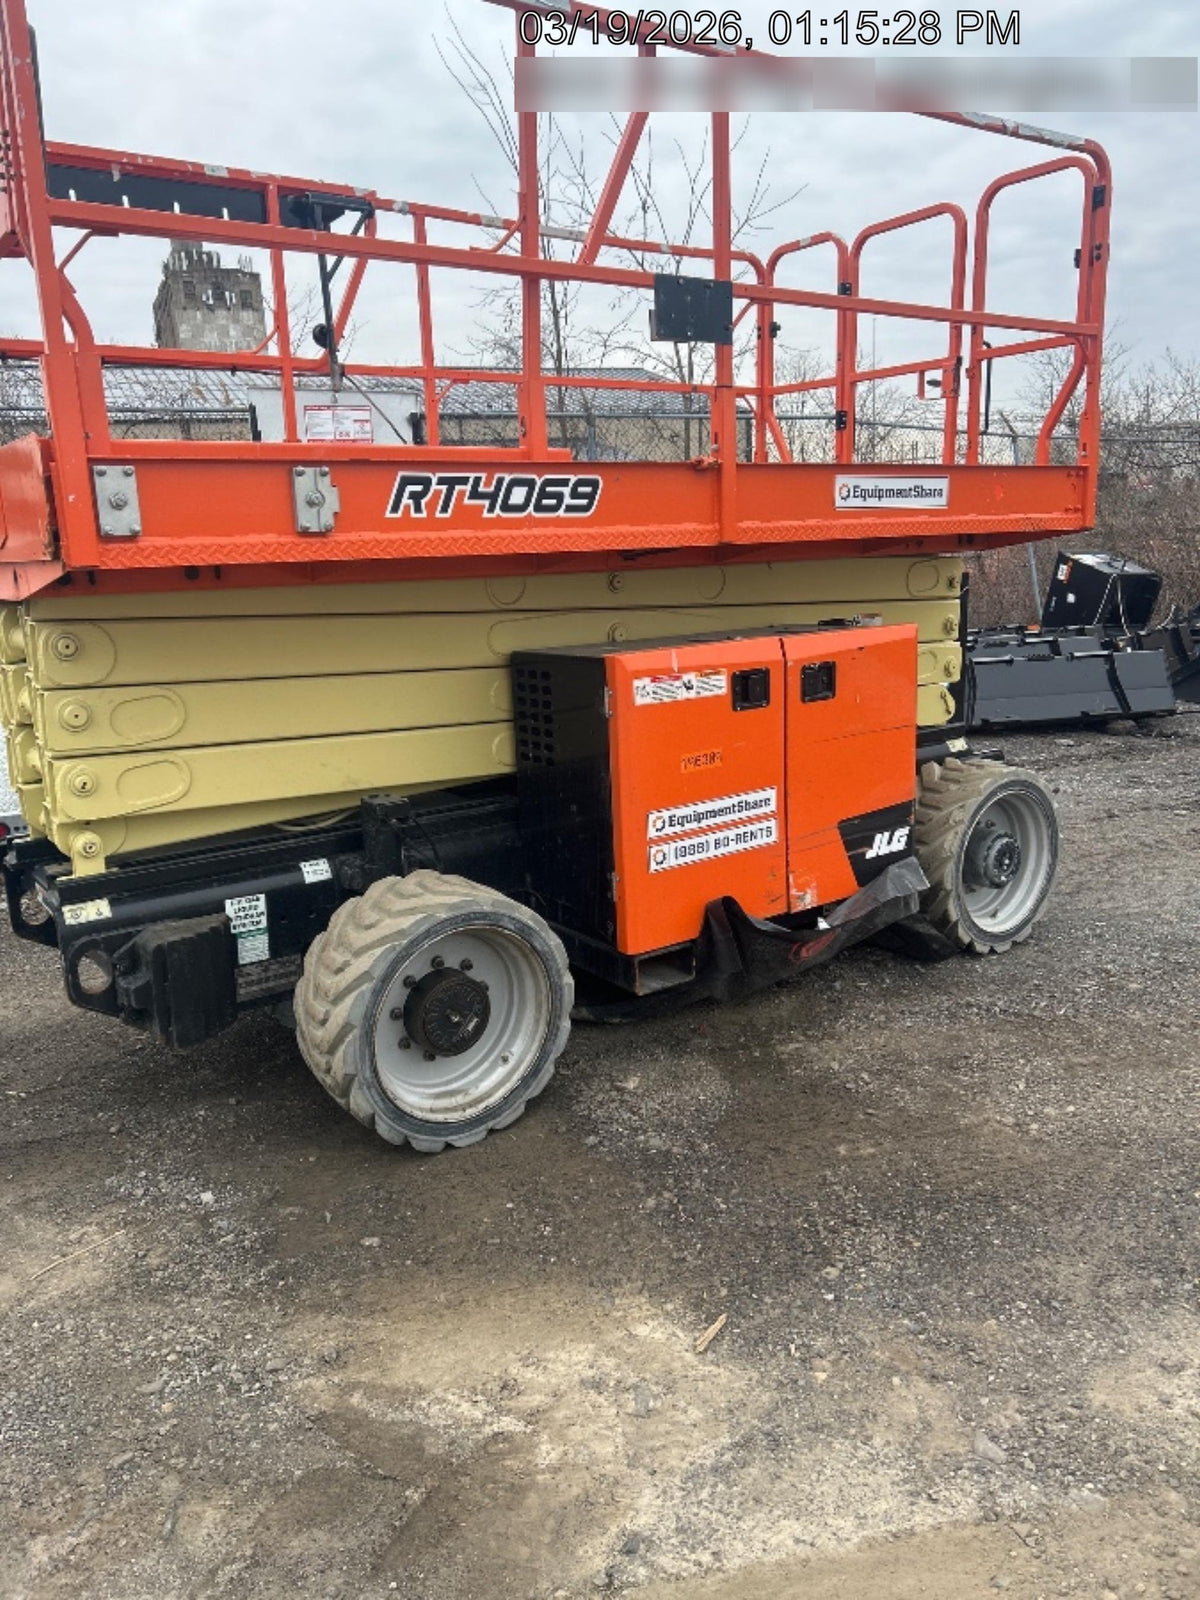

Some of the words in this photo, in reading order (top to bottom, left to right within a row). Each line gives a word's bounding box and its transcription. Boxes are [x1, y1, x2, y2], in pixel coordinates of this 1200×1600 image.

[385, 471, 603, 518] RT4069
[852, 484, 943, 502] EquipmentShare
[668, 797, 771, 828] EquipmentShare
[865, 826, 911, 859] JLG
